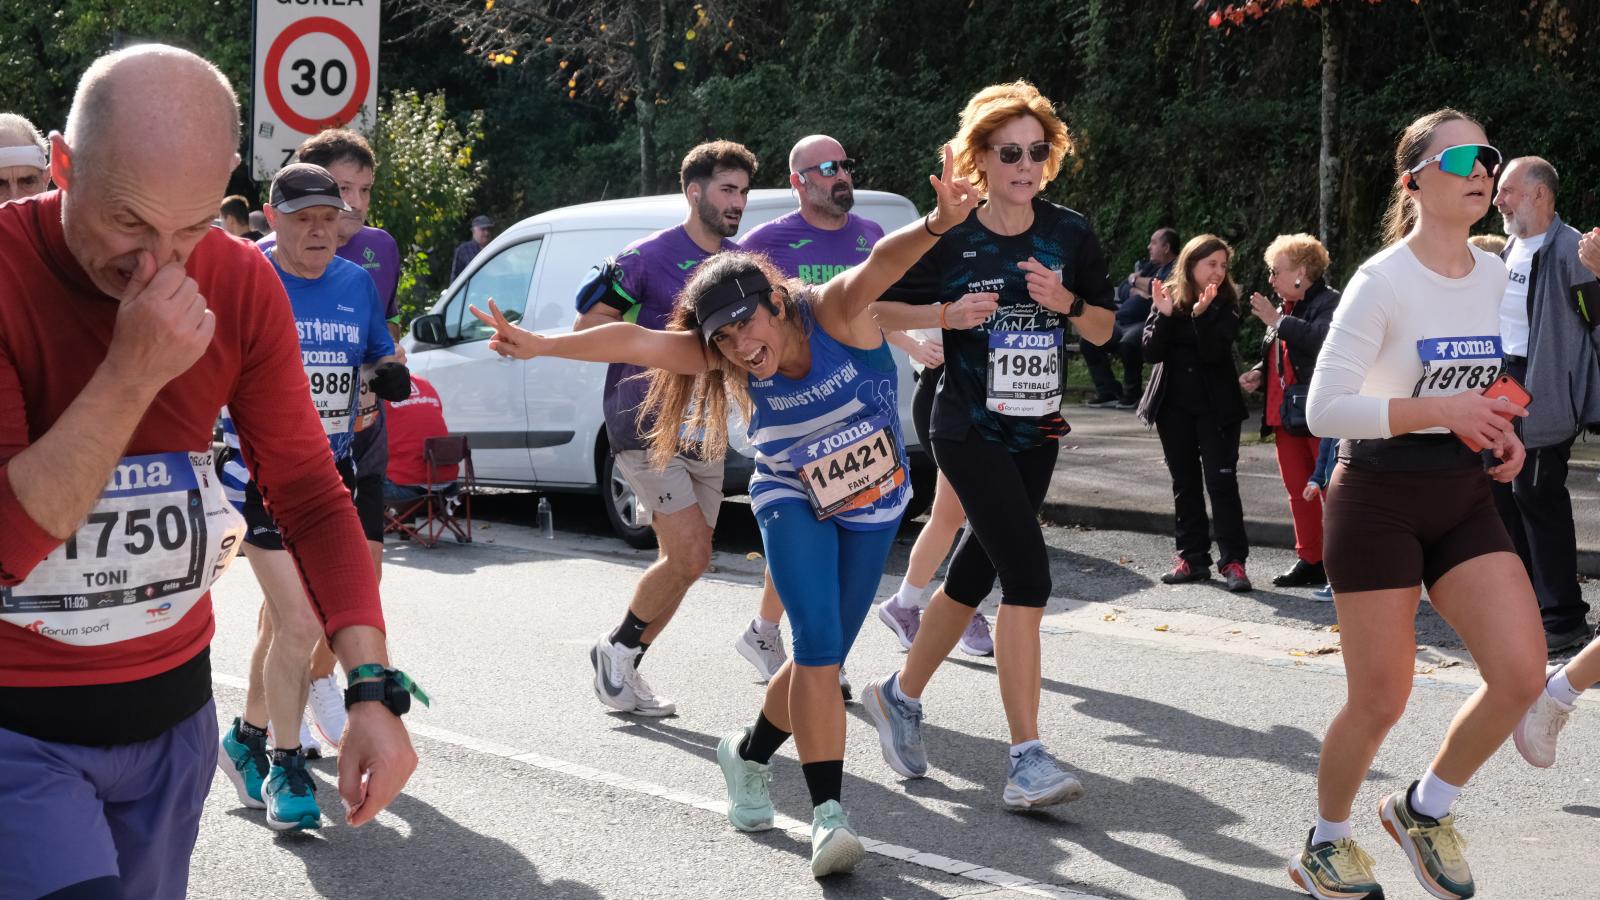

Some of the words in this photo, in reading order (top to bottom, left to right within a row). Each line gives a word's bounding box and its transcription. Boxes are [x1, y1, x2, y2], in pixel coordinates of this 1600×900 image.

[291, 58, 347, 96] 30
[799, 265, 856, 285] BEHO
[1508, 268, 1527, 284] tza
[1018, 334, 1054, 349] Joma
[1450, 340, 1496, 358] Joma
[997, 354, 1058, 376] 19846
[310, 372, 351, 395] 988
[1428, 365, 1498, 390] 19783
[313, 400, 328, 408] LIX
[821, 421, 873, 454] Joma
[811, 436, 888, 489] 14421
[107, 461, 172, 491] ma
[847, 474, 871, 491] FANY
[64, 505, 188, 560] 1750
[83, 569, 127, 587] TONI
[63, 595, 89, 609] 11:02h
[81, 622, 110, 635] sport
